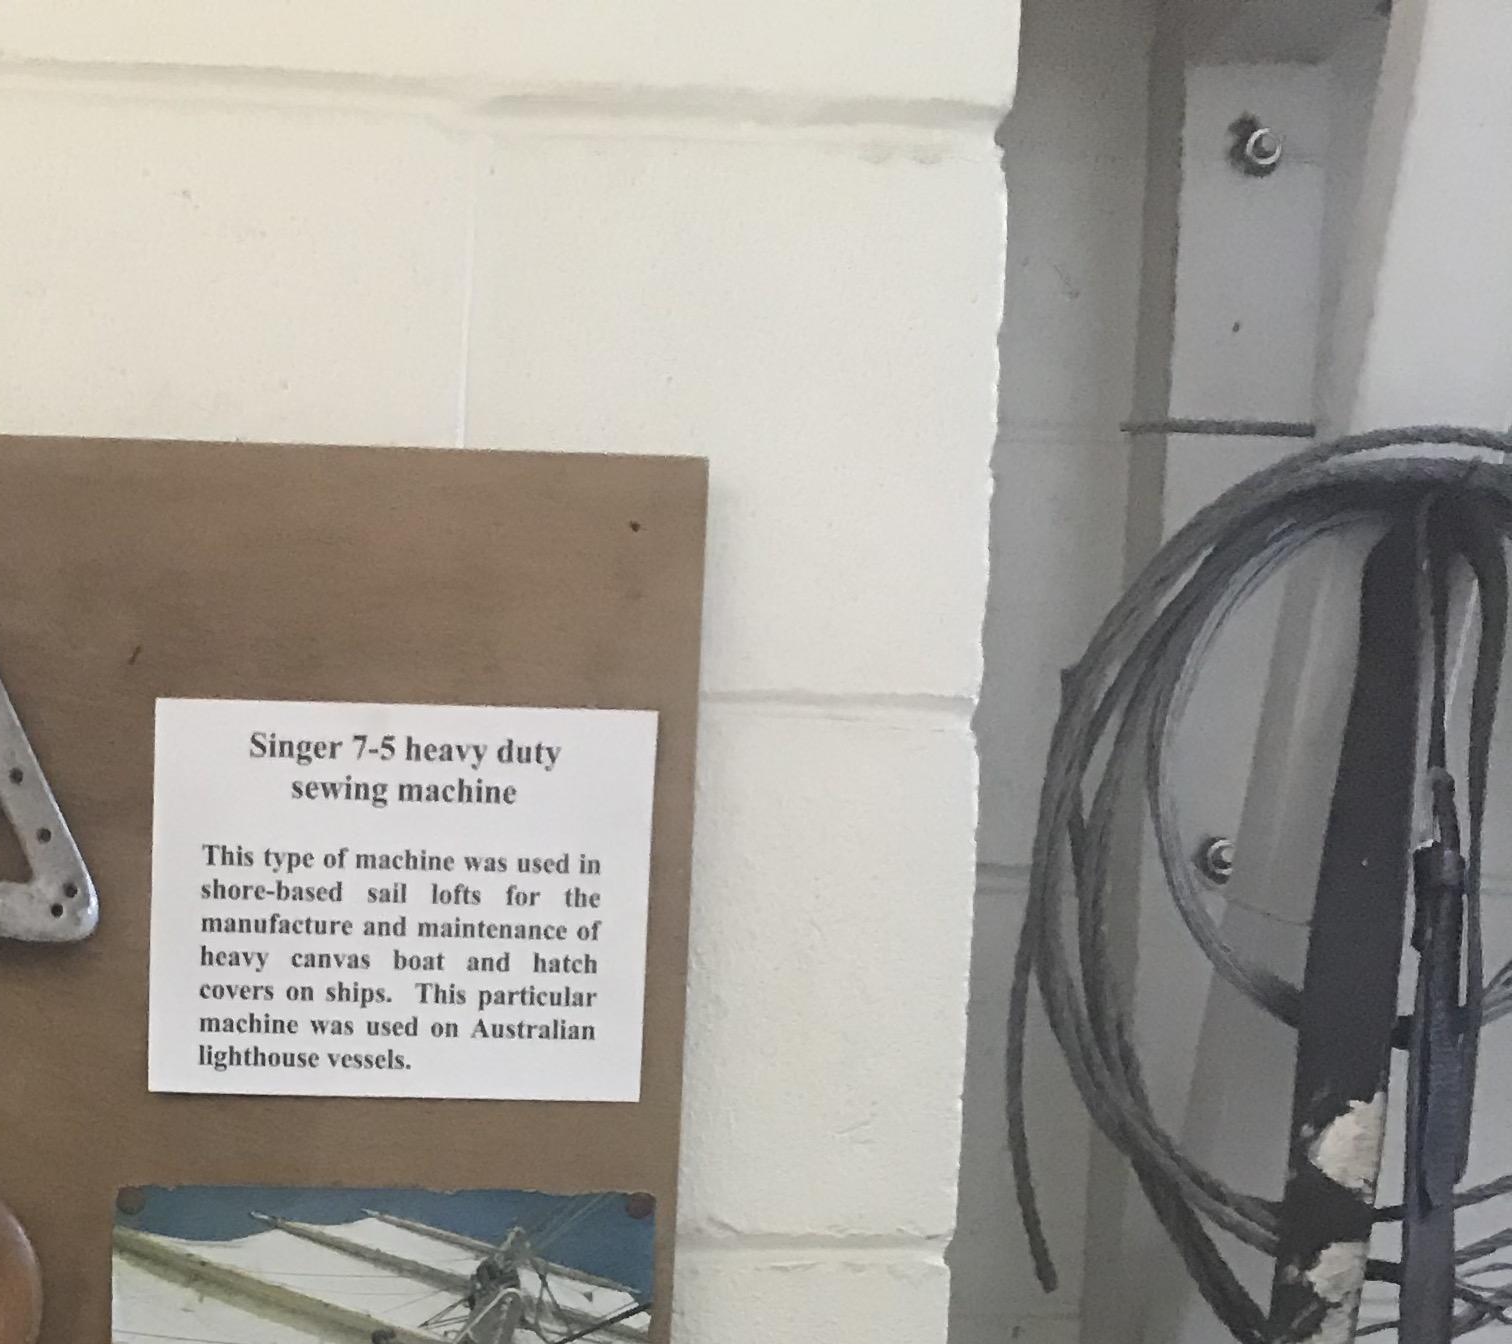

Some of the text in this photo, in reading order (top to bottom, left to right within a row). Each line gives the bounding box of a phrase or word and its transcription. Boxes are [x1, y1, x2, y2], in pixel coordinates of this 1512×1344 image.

[249, 731, 561, 772] Singer 7-5 heavy duty
[291, 774, 518, 809] sewing machine
[201, 843, 601, 876] This type of machine was used in
[200, 877, 601, 909] shore-based sail lofts for the
[201, 912, 603, 941] manufacture and maintenance of
[200, 944, 598, 975] heavy canvas boat and hatch
[199, 980, 598, 1012] covers on ships. This particular
[199, 1012, 596, 1041] machine was used on Australian
[199, 1044, 412, 1072] lighthouse vessels.
